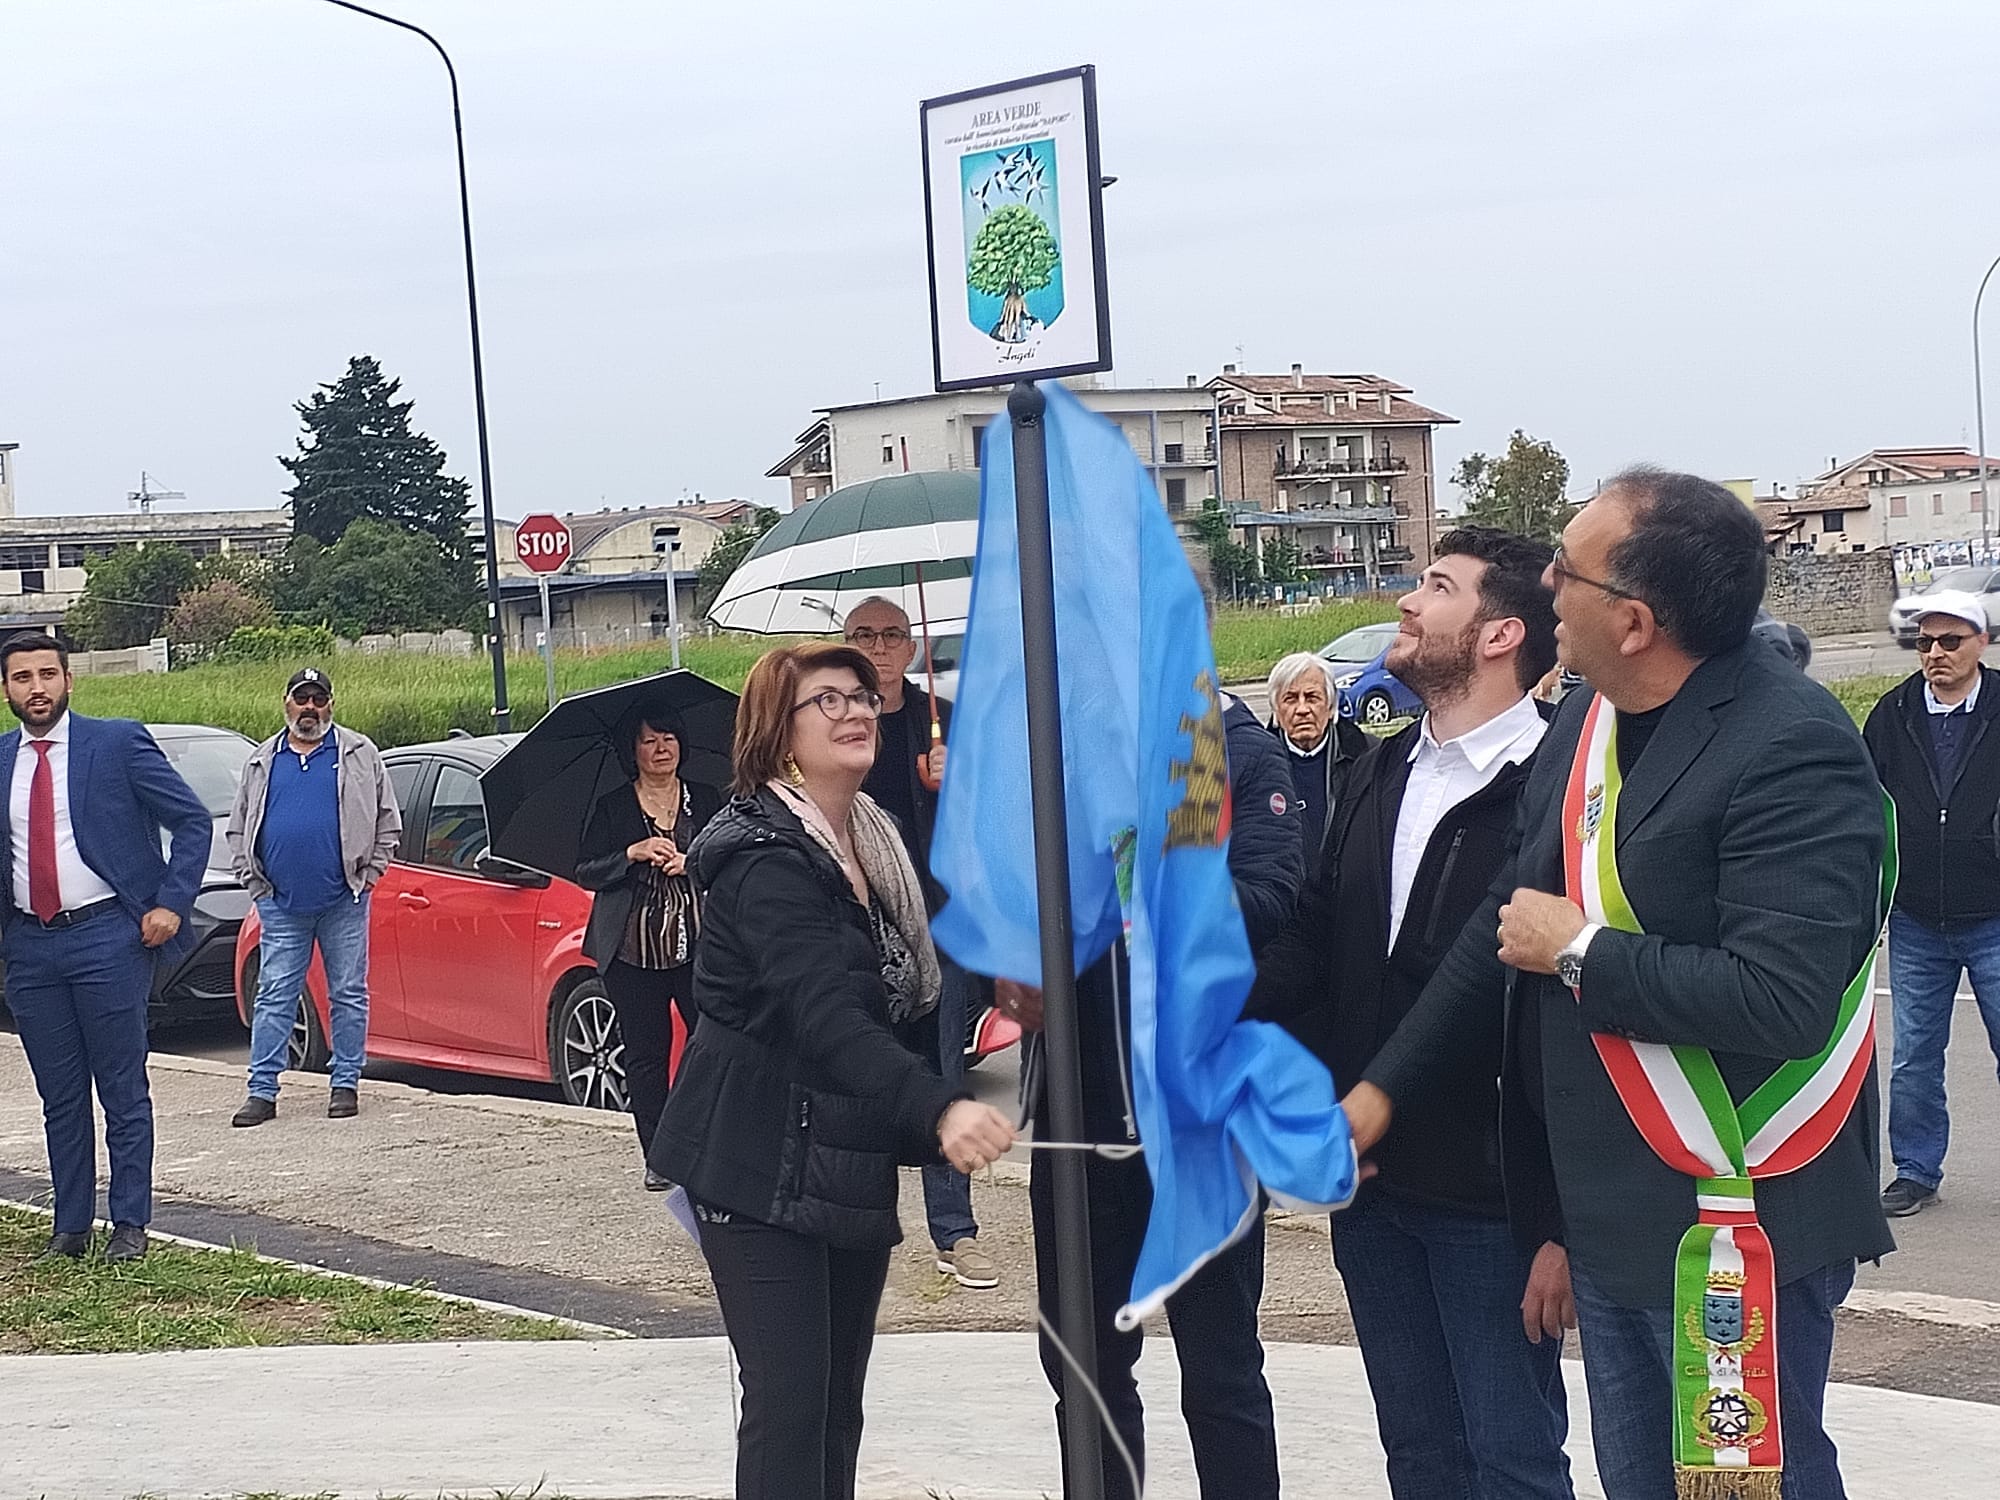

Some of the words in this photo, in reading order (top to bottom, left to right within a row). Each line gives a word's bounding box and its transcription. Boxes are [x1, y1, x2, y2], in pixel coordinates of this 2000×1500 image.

[971, 112, 1000, 128] AREA
[1004, 101, 1042, 122] VERDE
[518, 531, 568, 556] STOP
[1717, 1367, 1727, 1376] di
